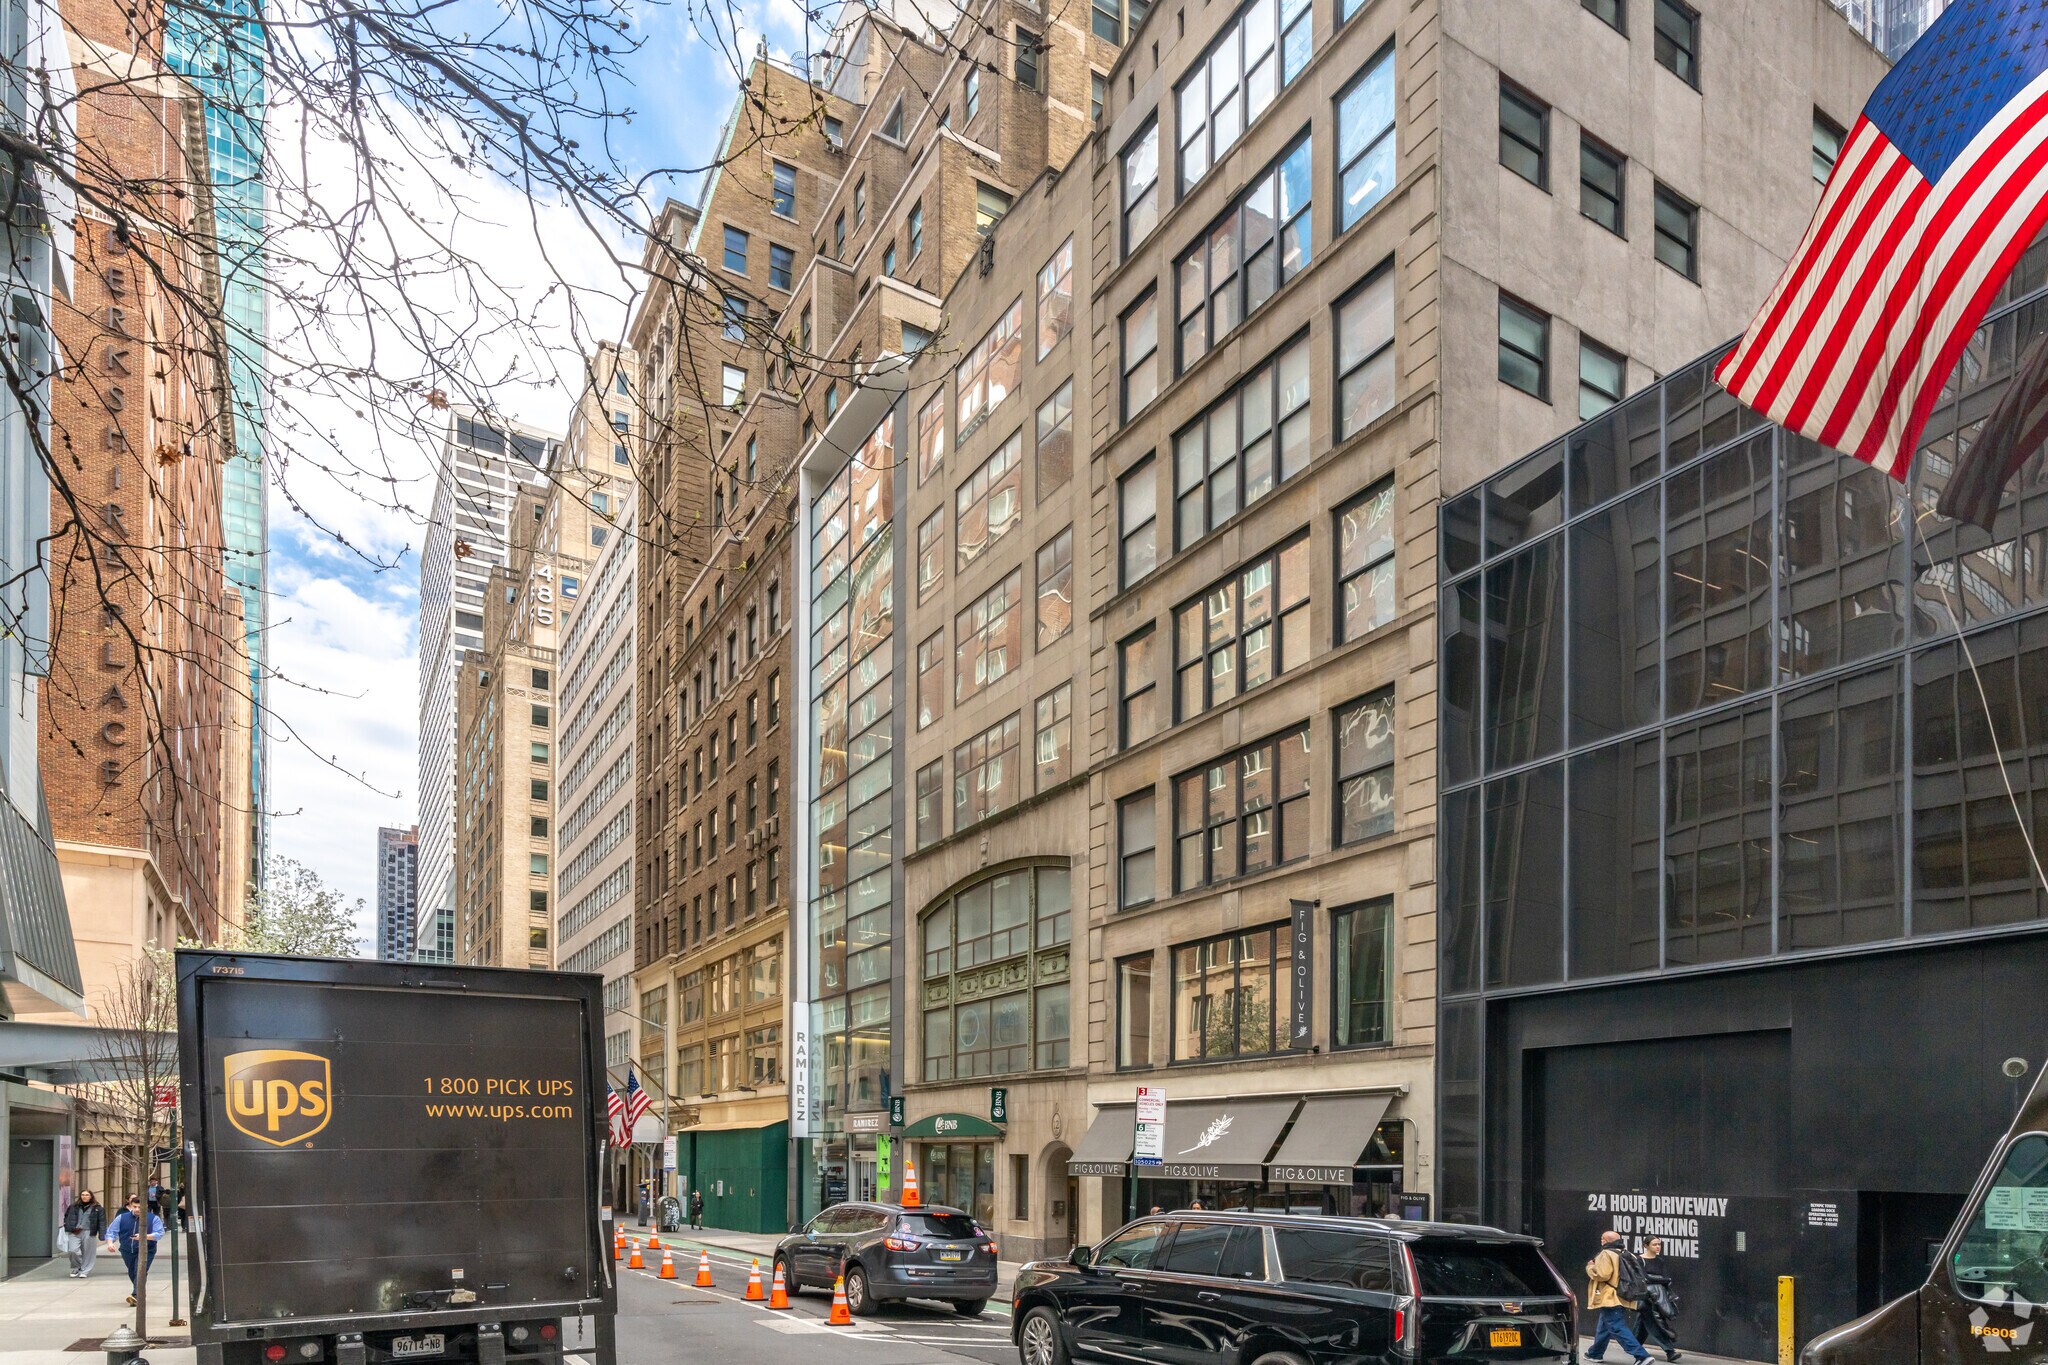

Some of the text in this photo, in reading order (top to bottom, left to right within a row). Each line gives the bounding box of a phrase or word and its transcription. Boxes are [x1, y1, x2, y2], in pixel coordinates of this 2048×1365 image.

[537, 564, 555, 626] 485
[102, 601, 128, 786] PLACE
[212, 966, 246, 976] 173715
[1297, 910, 1307, 1023] FIG & OLIVE
[795, 1031, 807, 1121] RAMIREZ
[423, 1077, 574, 1096] 1 800 PICK UPS
[1140, 1088, 1146, 1096] 3
[233, 1079, 326, 1132] ups
[425, 1104, 573, 1122] www.ups.com
[853, 1118, 879, 1128] RAMIREZ
[944, 1119, 958, 1130] BNB
[1074, 1163, 1118, 1175] FIG&OLIVE
[1164, 1165, 1219, 1177] FIG&OLIVE
[1275, 1167, 1345, 1182] FIG&OLIVE
[1588, 1193, 1728, 1217] 24 HOUR DRIVEWAY
[1612, 1215, 1699, 1237] NO PARKING
[1633, 1235, 1699, 1258] ATIME
[1970, 1325, 2018, 1339] 166908
[397, 1338, 441, 1352] 96714-NB
